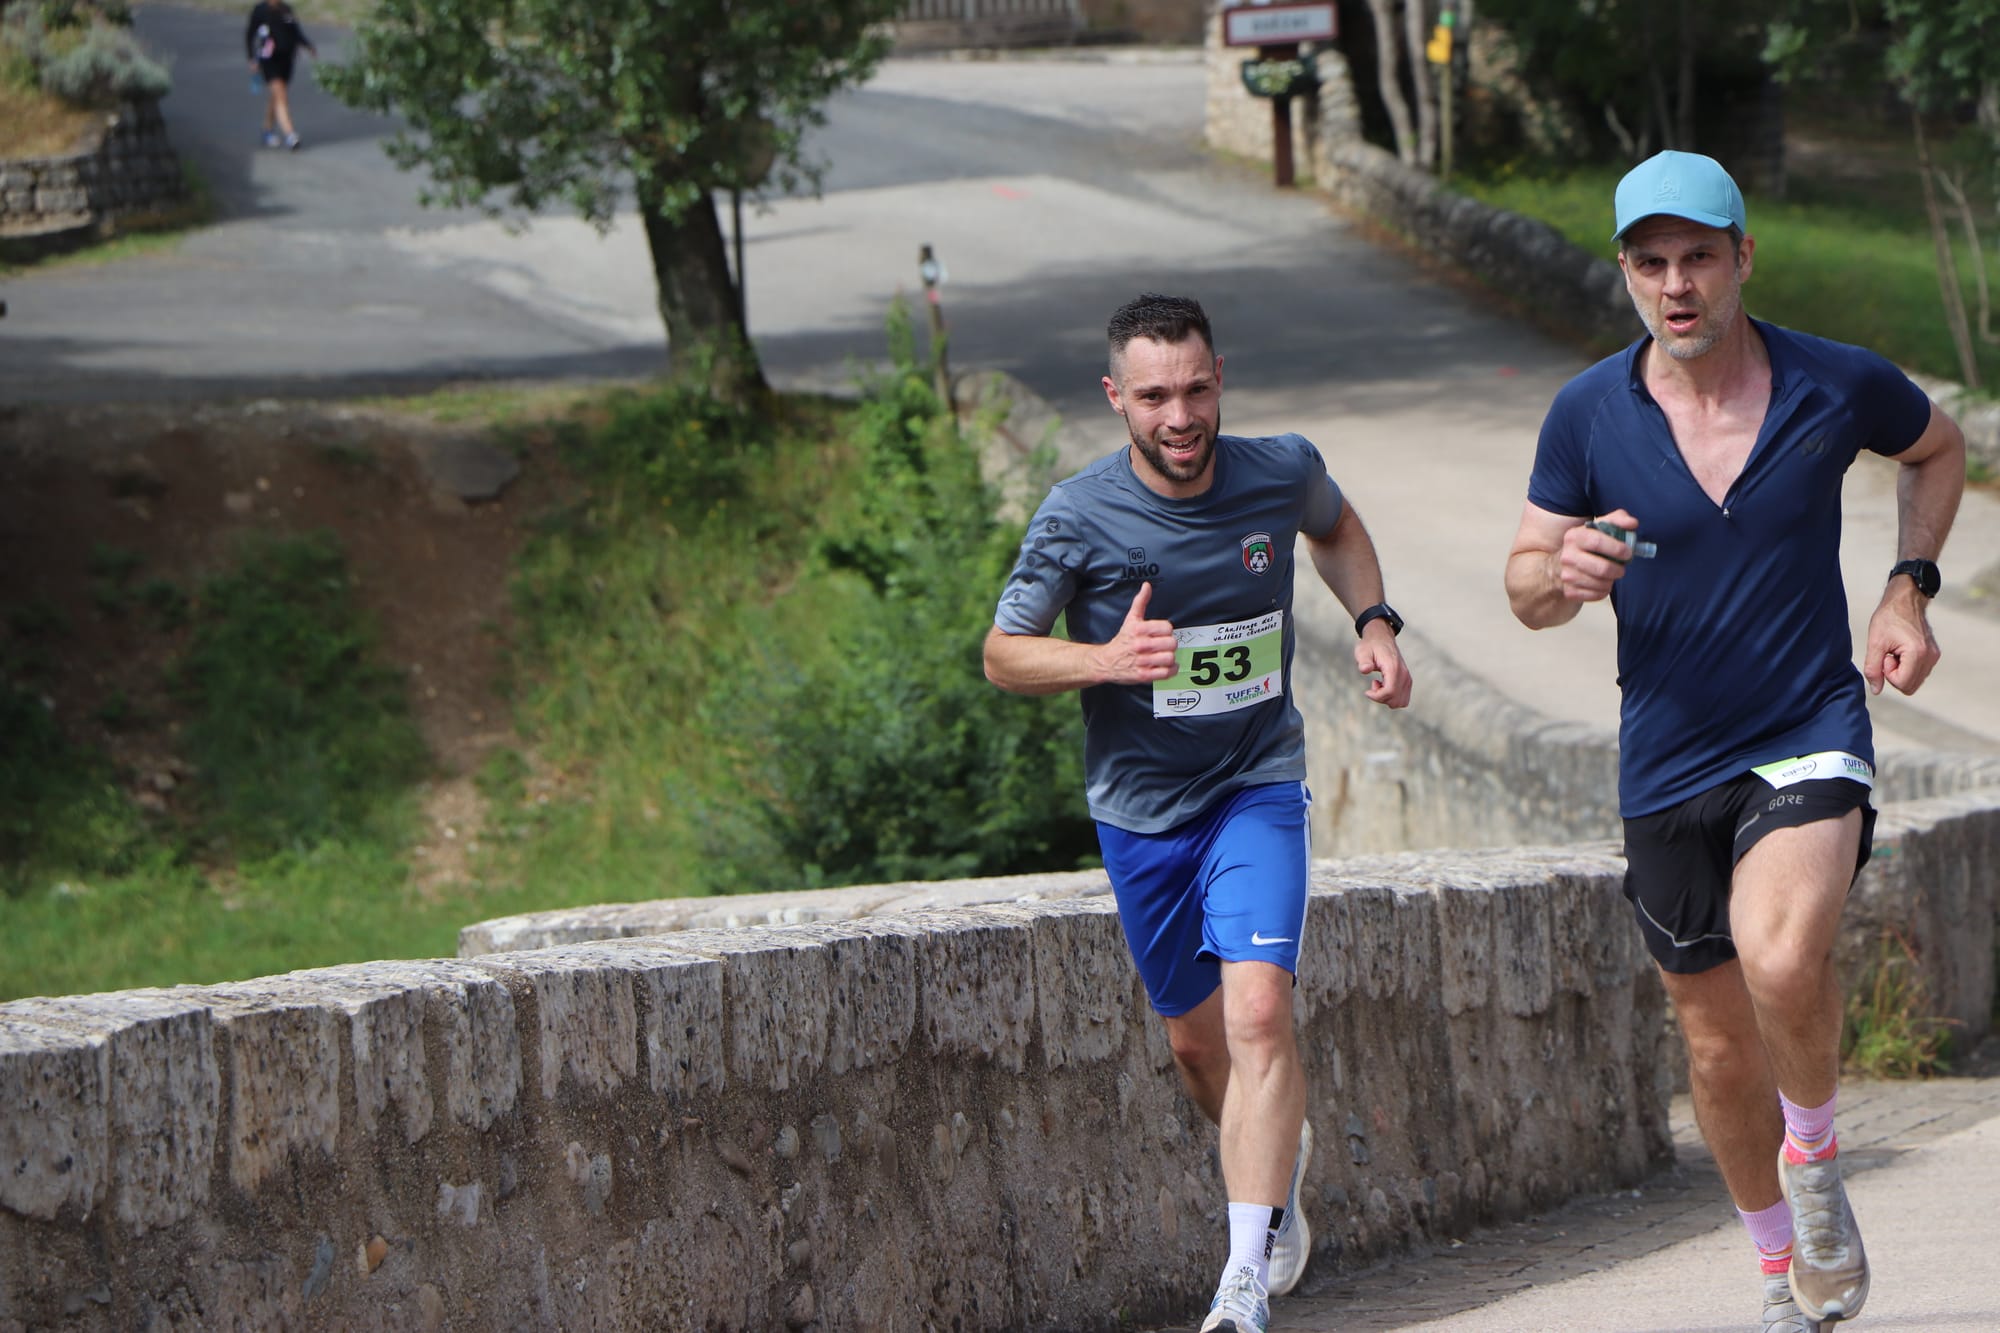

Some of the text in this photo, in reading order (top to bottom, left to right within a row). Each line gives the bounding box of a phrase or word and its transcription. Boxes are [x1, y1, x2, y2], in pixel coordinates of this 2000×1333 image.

[1121, 563, 1160, 579] JAKO
[1218, 616, 1274, 634] Challenge des
[1189, 645, 1252, 686] 53
[1167, 697, 1197, 706] BFP
[1225, 685, 1261, 701] TUFF'S
[1768, 794, 1805, 811] GORE
[1264, 1231, 1276, 1262] NIKE
